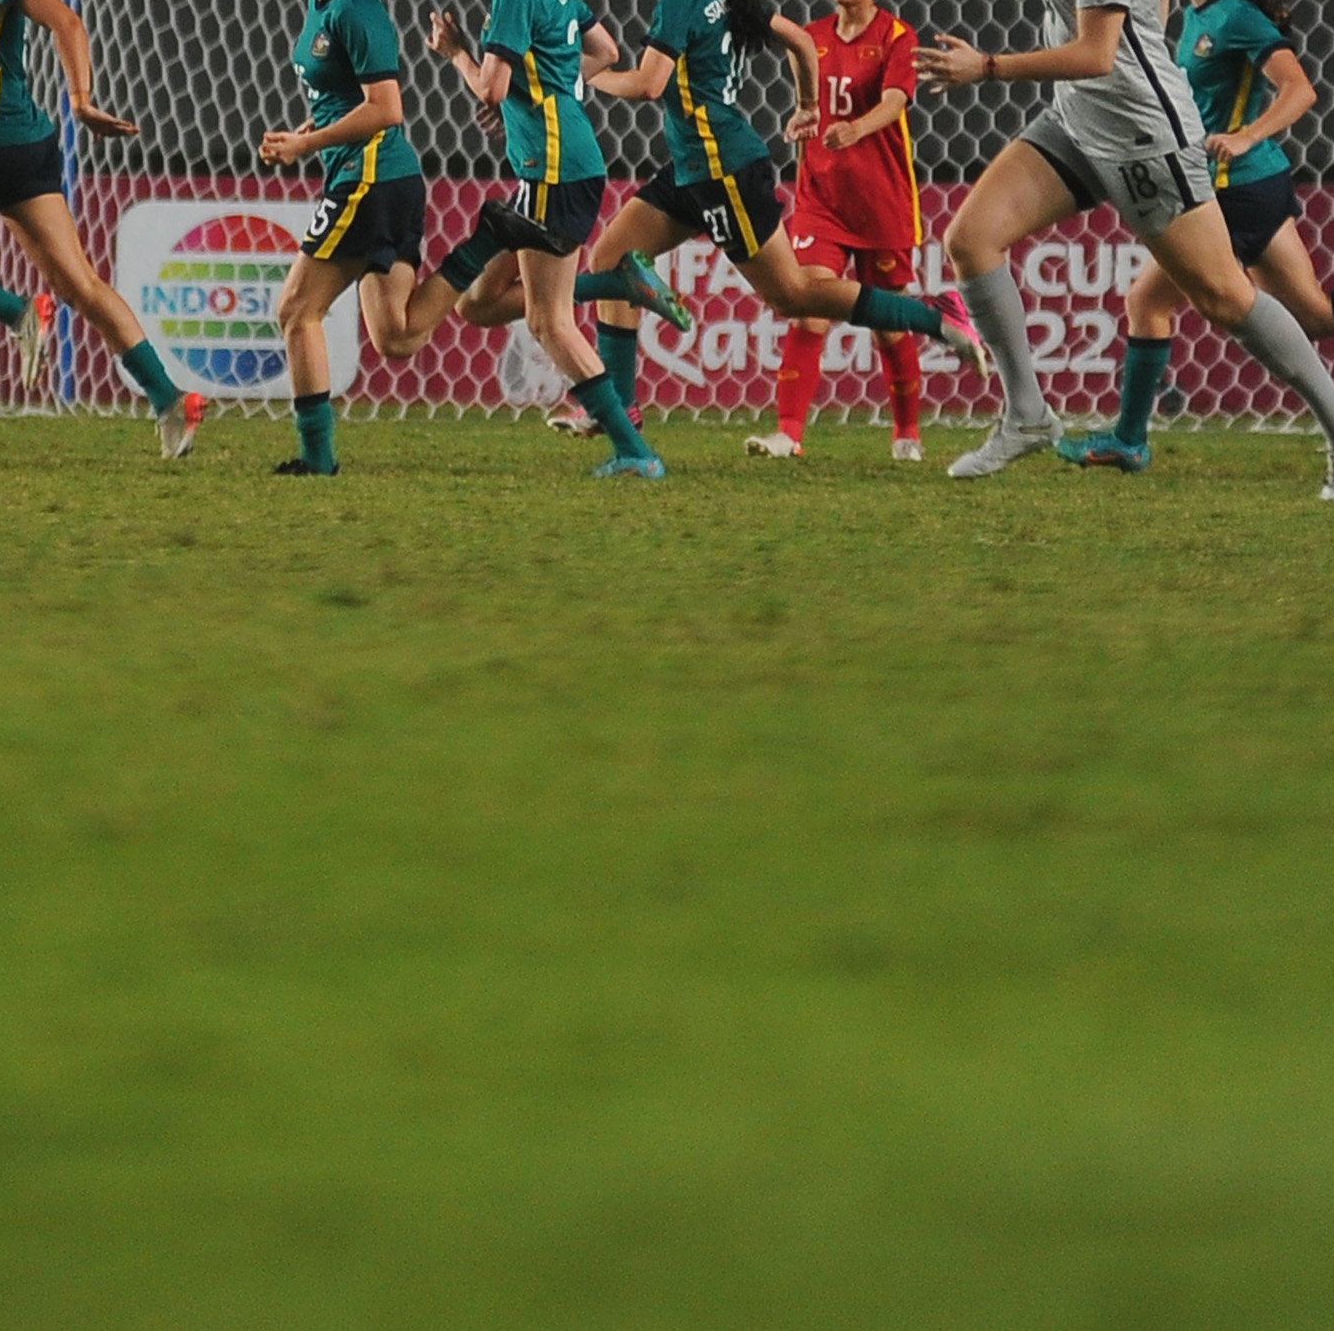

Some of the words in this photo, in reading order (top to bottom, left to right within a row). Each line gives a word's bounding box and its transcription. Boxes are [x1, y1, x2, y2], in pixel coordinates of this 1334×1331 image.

[827, 76, 854, 116] 15
[1117, 163, 1160, 204] 18
[702, 205, 734, 250] 27
